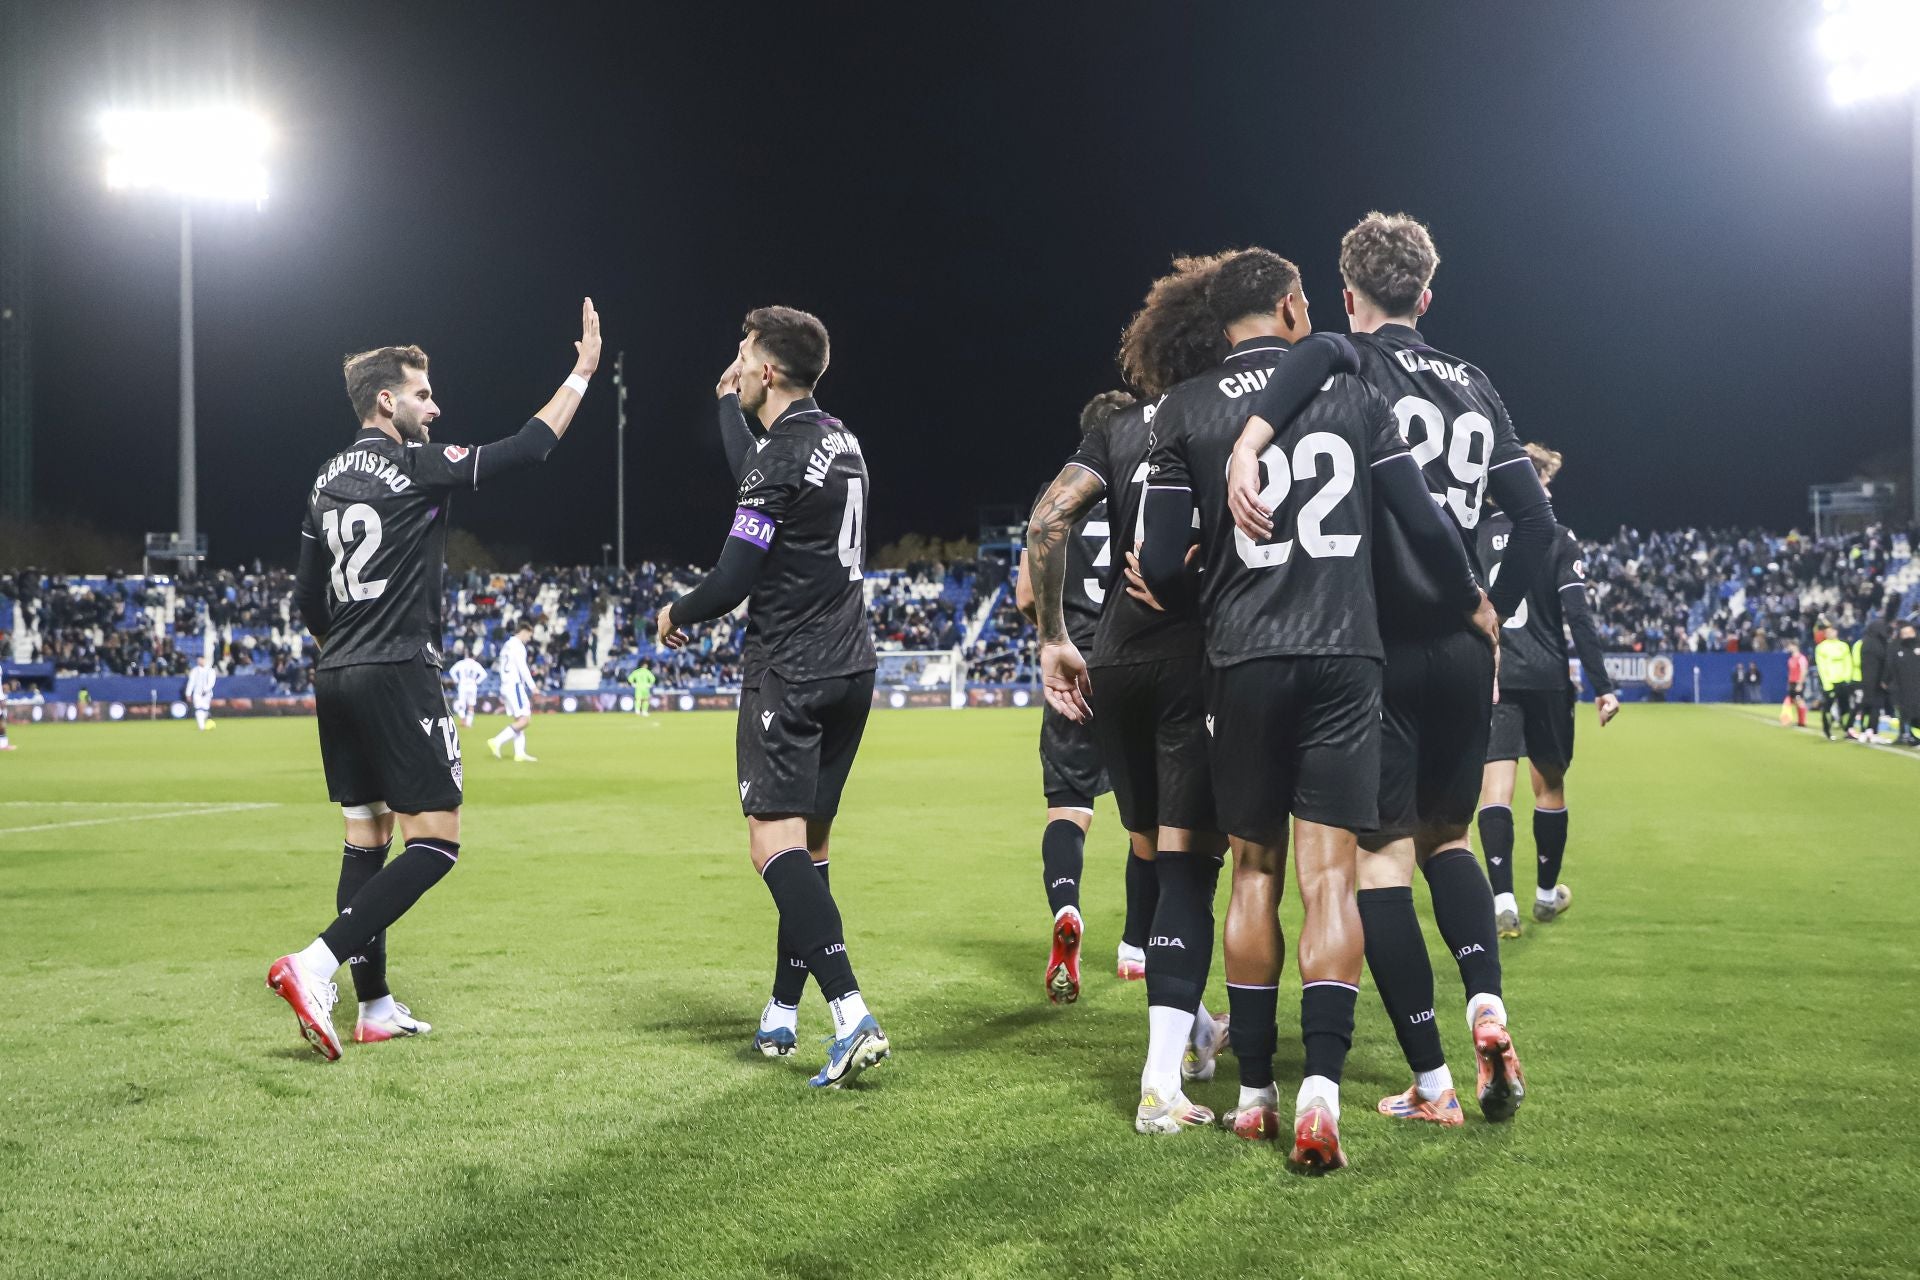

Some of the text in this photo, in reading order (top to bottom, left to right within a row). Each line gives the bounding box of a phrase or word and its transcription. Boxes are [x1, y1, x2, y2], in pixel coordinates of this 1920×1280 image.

[1225, 431, 1362, 569] 22
[734, 514, 776, 544] 25N
[838, 477, 863, 581] 4
[322, 503, 388, 602] 12
[437, 715, 462, 761] 12
[1052, 877, 1076, 888] UDA
[1149, 936, 1186, 949] UDA
[1455, 943, 1485, 960] UDA
[1410, 1008, 1435, 1025] UDA
